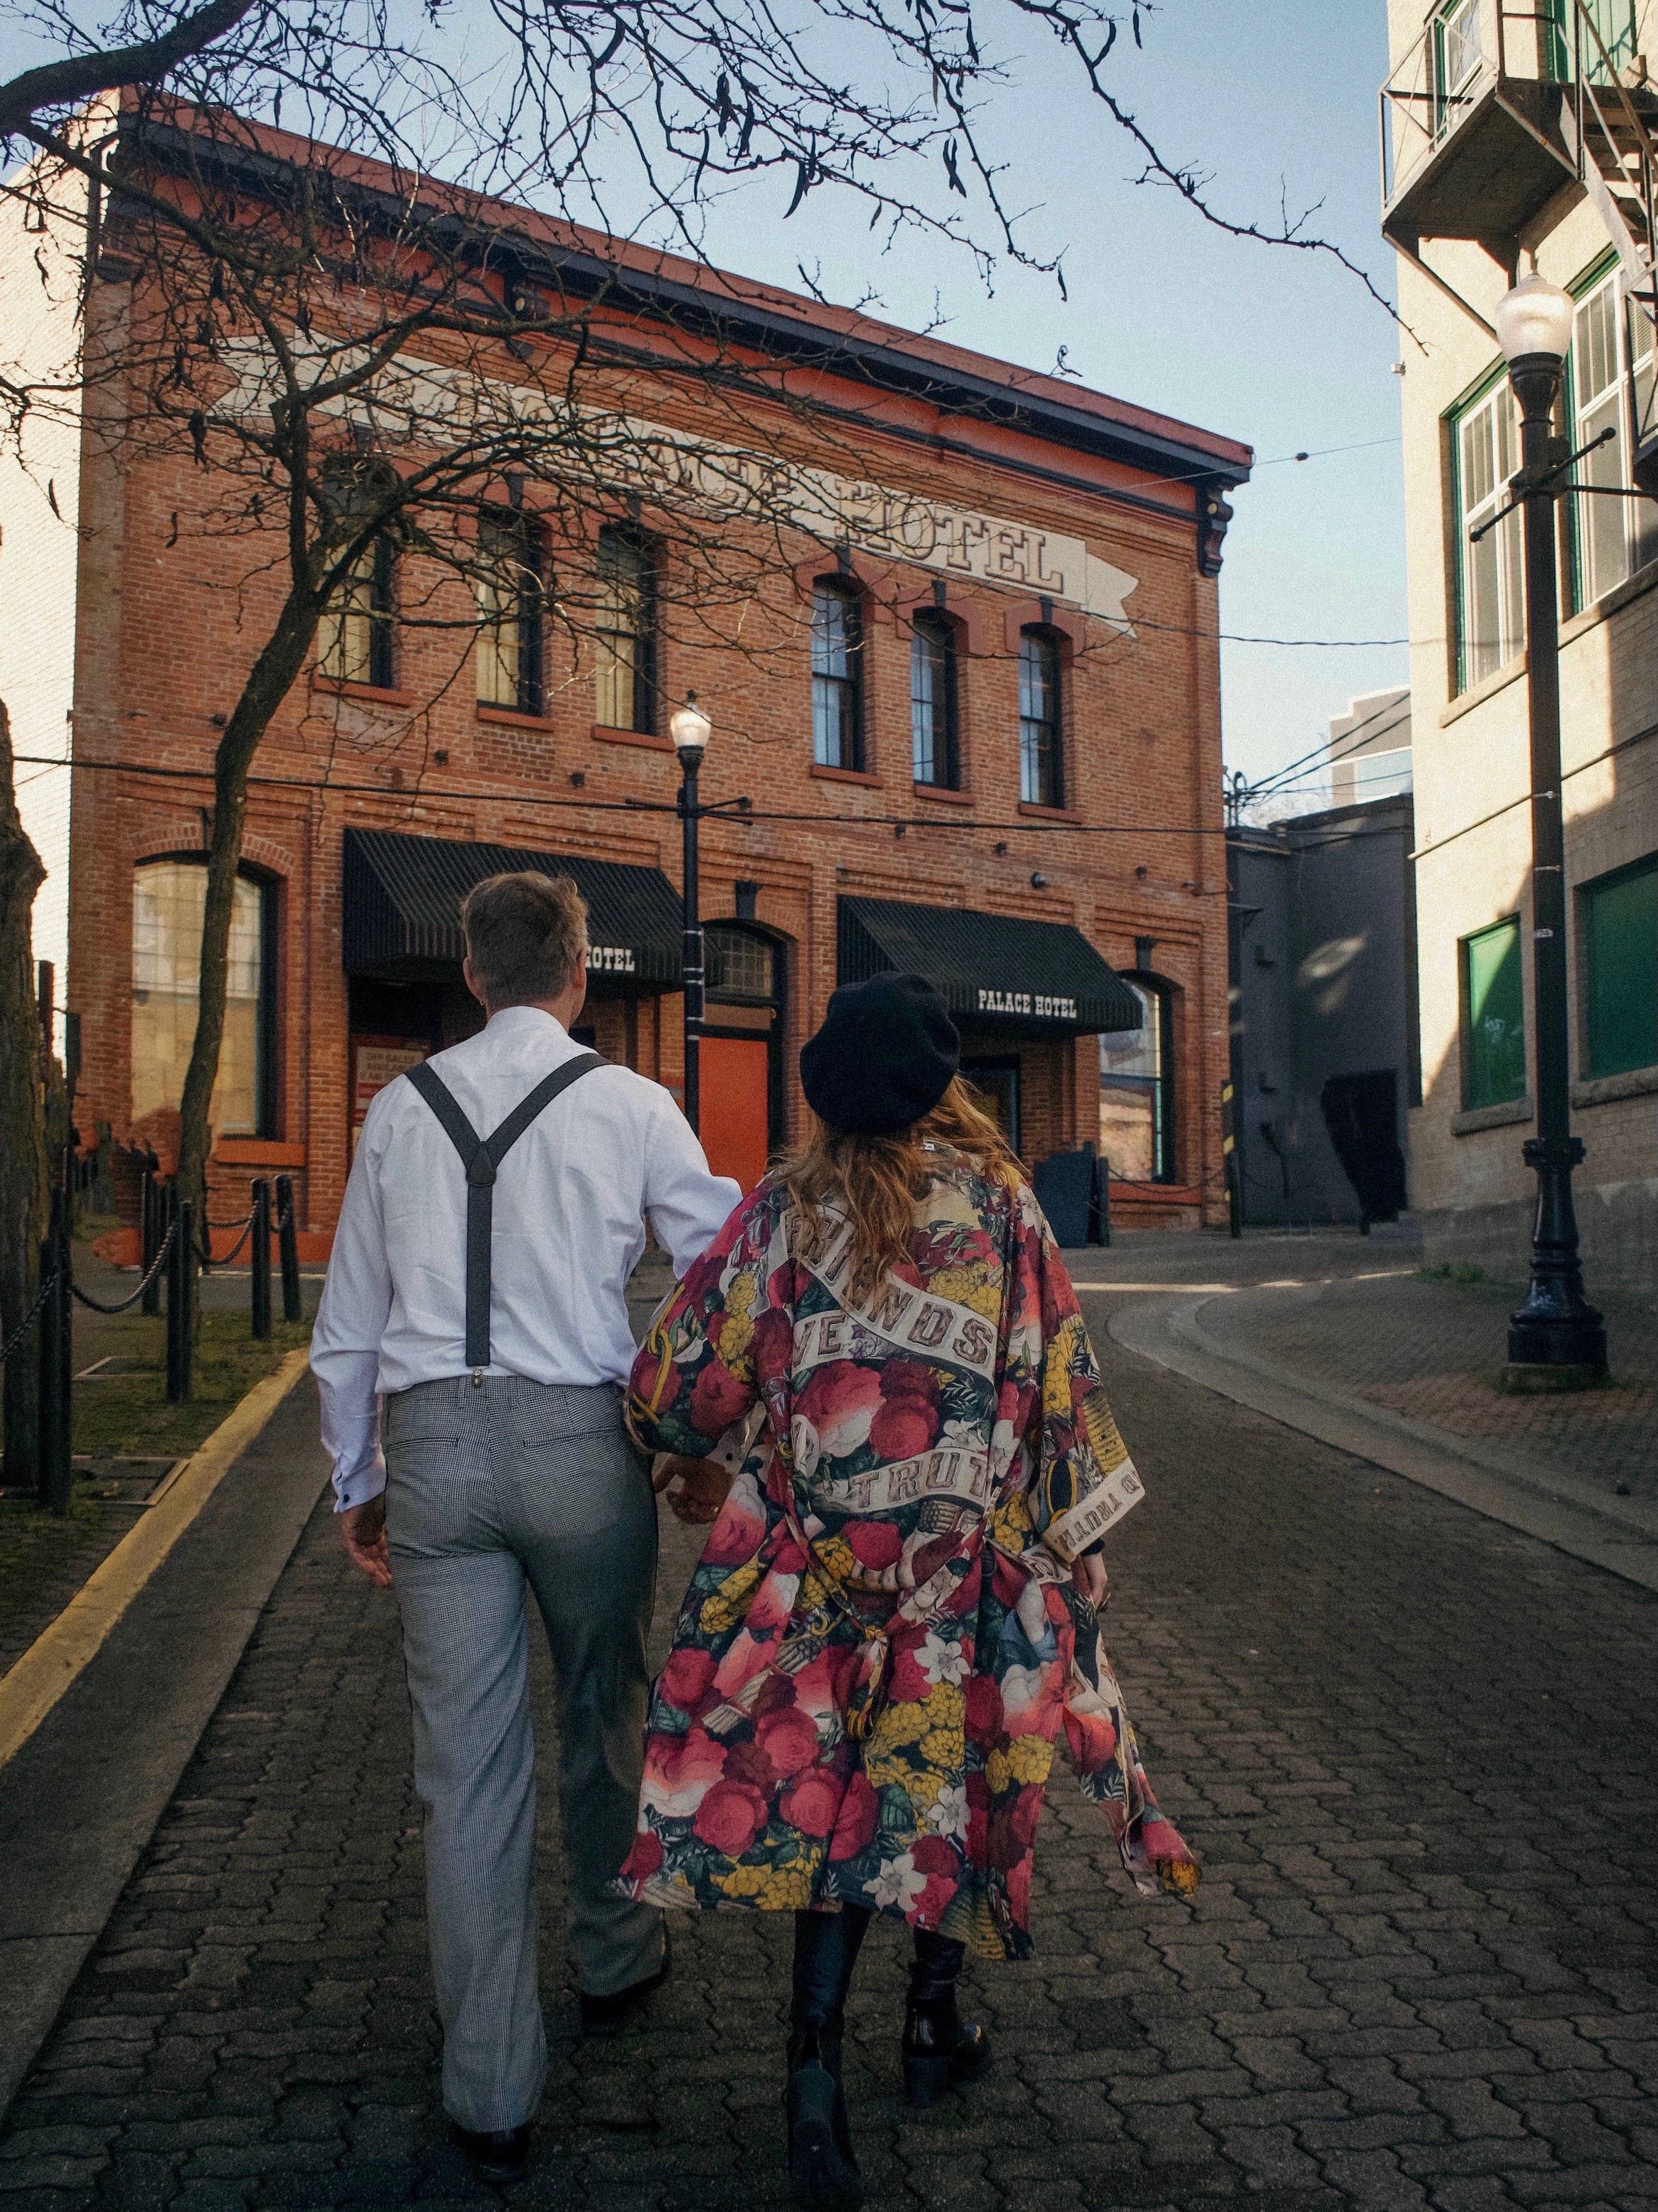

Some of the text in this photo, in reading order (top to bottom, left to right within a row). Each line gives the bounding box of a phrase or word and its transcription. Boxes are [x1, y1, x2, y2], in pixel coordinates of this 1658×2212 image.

[834, 479, 1064, 593] HOTEL
[978, 989, 1077, 1018] PALACE HOTEL
